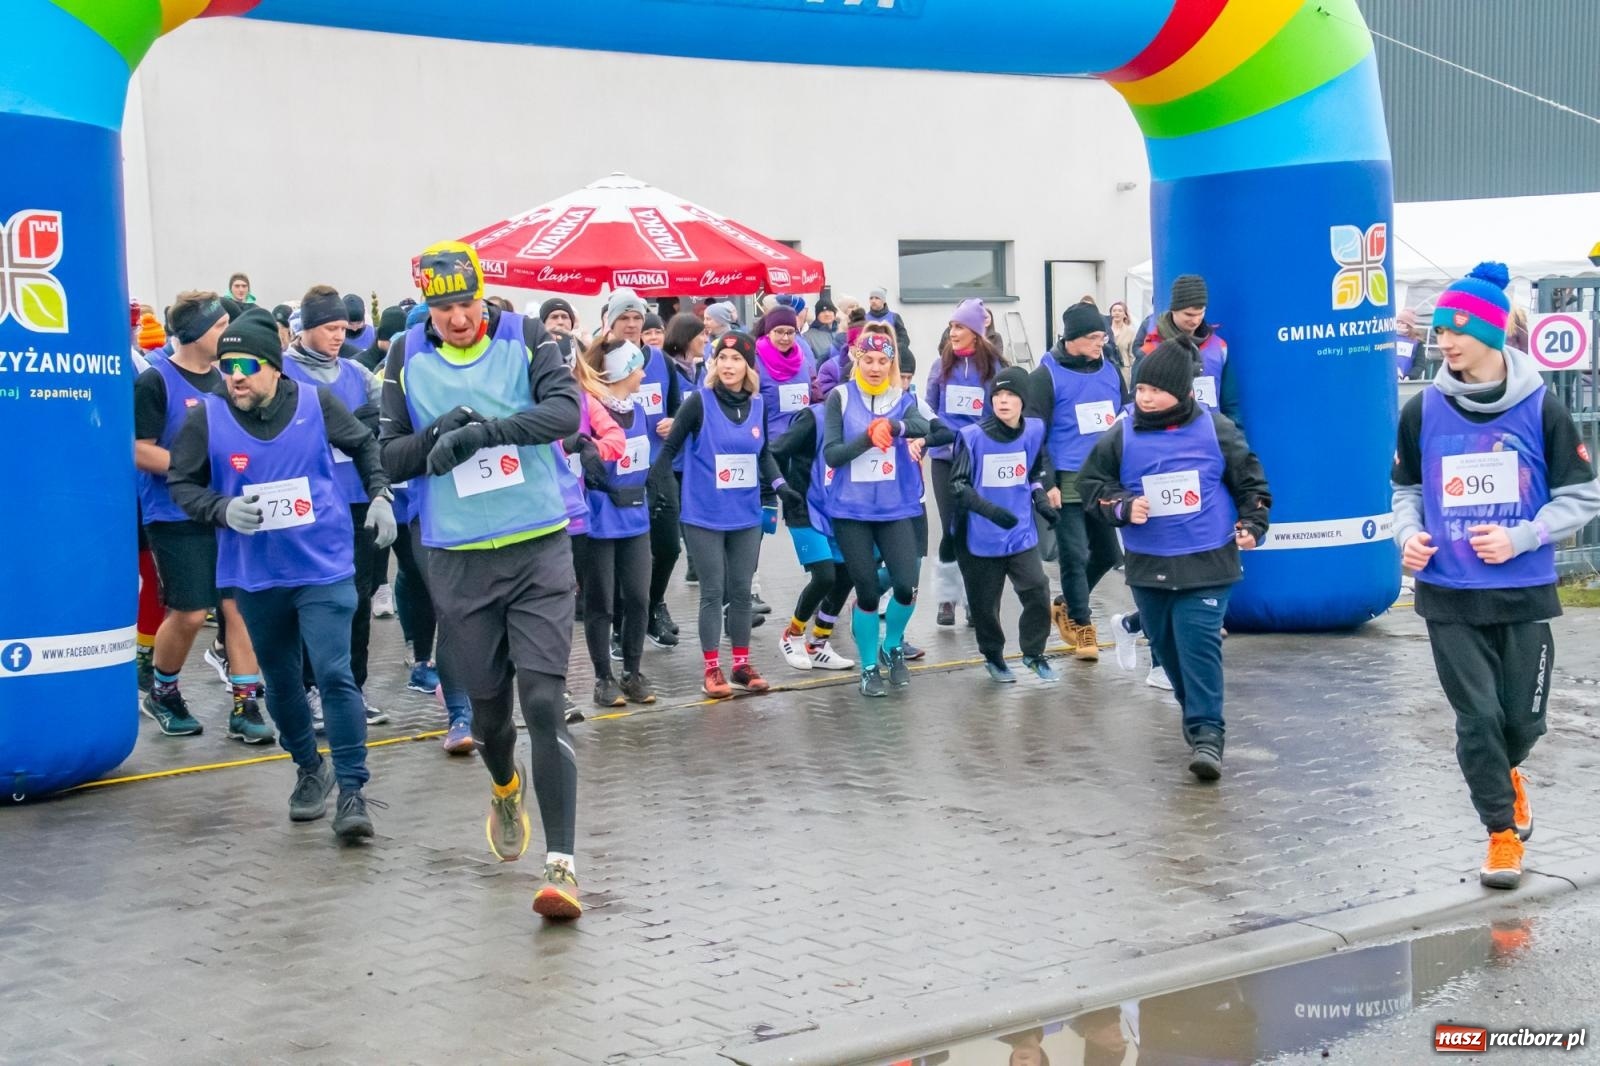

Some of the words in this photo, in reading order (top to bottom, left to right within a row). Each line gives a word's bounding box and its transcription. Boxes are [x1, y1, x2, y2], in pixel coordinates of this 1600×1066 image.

[531, 209, 591, 255] WARKA
[635, 208, 685, 259] WARKA
[537, 265, 582, 283] Classic
[617, 273, 665, 286] WARKA
[700, 269, 743, 288] Classic
[1277, 323, 1336, 342] GMINA
[1544, 330, 1574, 353] 20
[1317, 346, 1344, 356] odkryj
[1348, 344, 1371, 355] poznaj
[30, 387, 92, 401] zapamiętaj
[791, 393, 803, 405] 29
[956, 396, 972, 407] 27
[1095, 412, 1103, 425] 3
[478, 458, 493, 479] 5
[730, 468, 745, 481] 72
[870, 459, 879, 473] 7
[997, 466, 1014, 479] 63
[1466, 474, 1495, 495] 96
[1160, 488, 1183, 506] 95
[267, 498, 293, 518] 73
